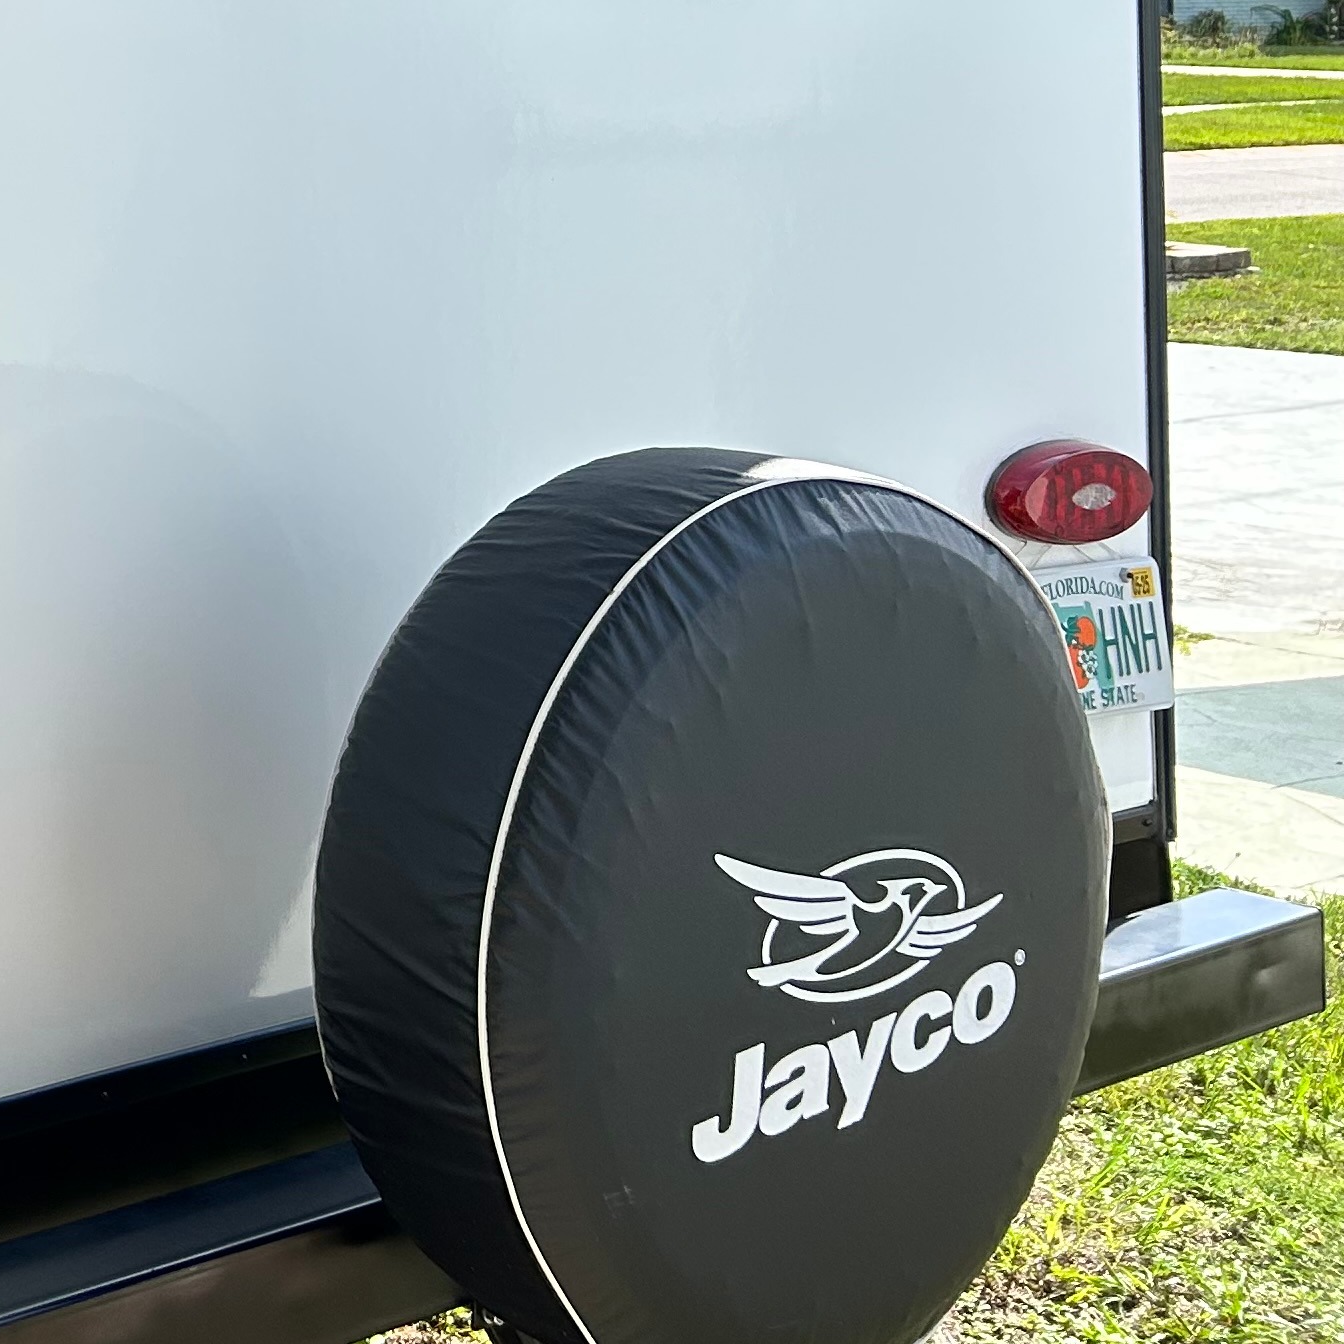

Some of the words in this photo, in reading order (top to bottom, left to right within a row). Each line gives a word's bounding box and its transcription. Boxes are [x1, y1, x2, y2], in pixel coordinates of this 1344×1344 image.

[1098, 601, 1163, 680] HNH
[1101, 684, 1138, 708] STATE
[691, 960, 1017, 1163] Jayco
